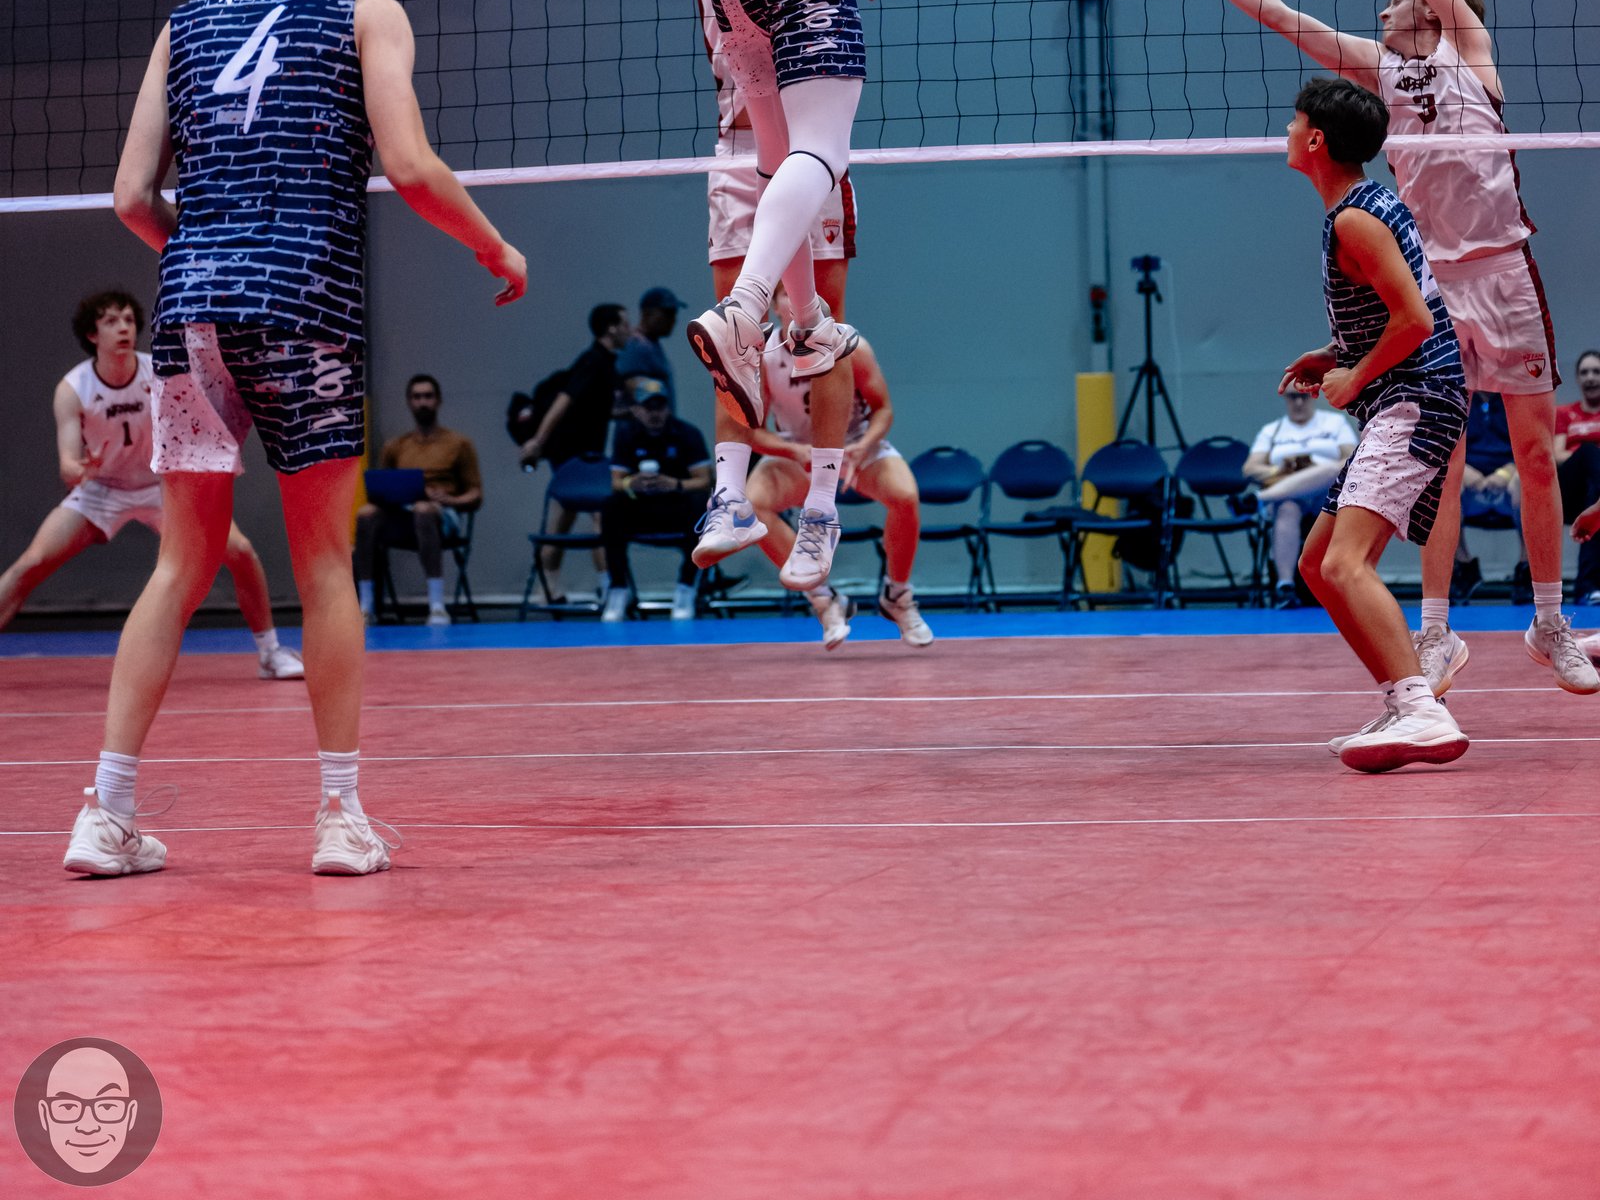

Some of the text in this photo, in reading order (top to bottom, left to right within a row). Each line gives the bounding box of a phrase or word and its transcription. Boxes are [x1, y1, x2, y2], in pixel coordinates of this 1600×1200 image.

[212, 4, 286, 134] 4
[1412, 94, 1438, 125] 3
[122, 421, 133, 447] 1
